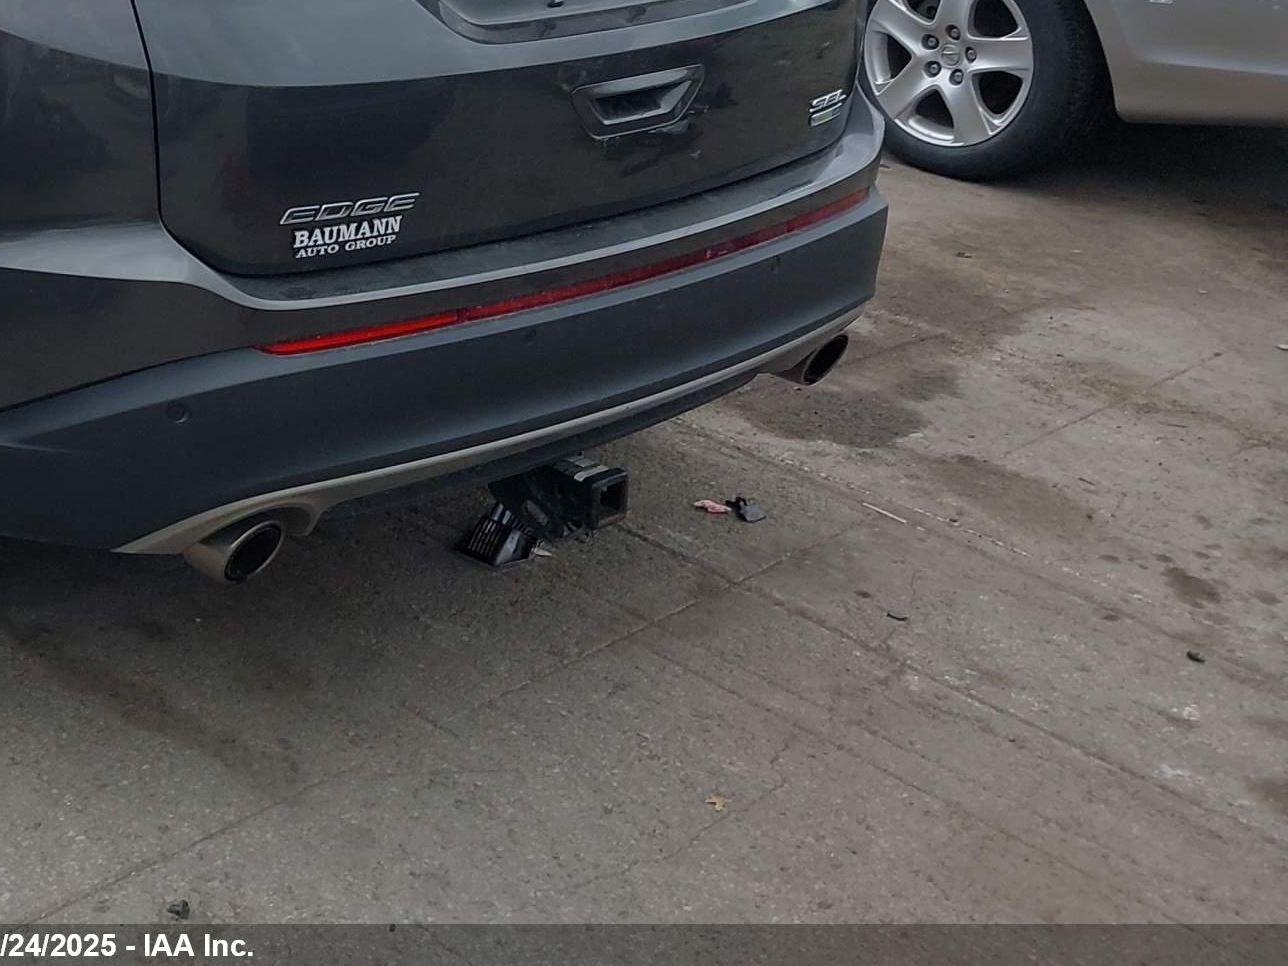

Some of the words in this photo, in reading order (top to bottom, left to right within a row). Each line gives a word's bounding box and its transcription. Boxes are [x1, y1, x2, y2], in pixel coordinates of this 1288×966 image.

[279, 192, 421, 225] EDGE
[293, 215, 403, 249] BAUMANN
[295, 244, 340, 259] AUTO
[344, 234, 397, 252] GROUP
